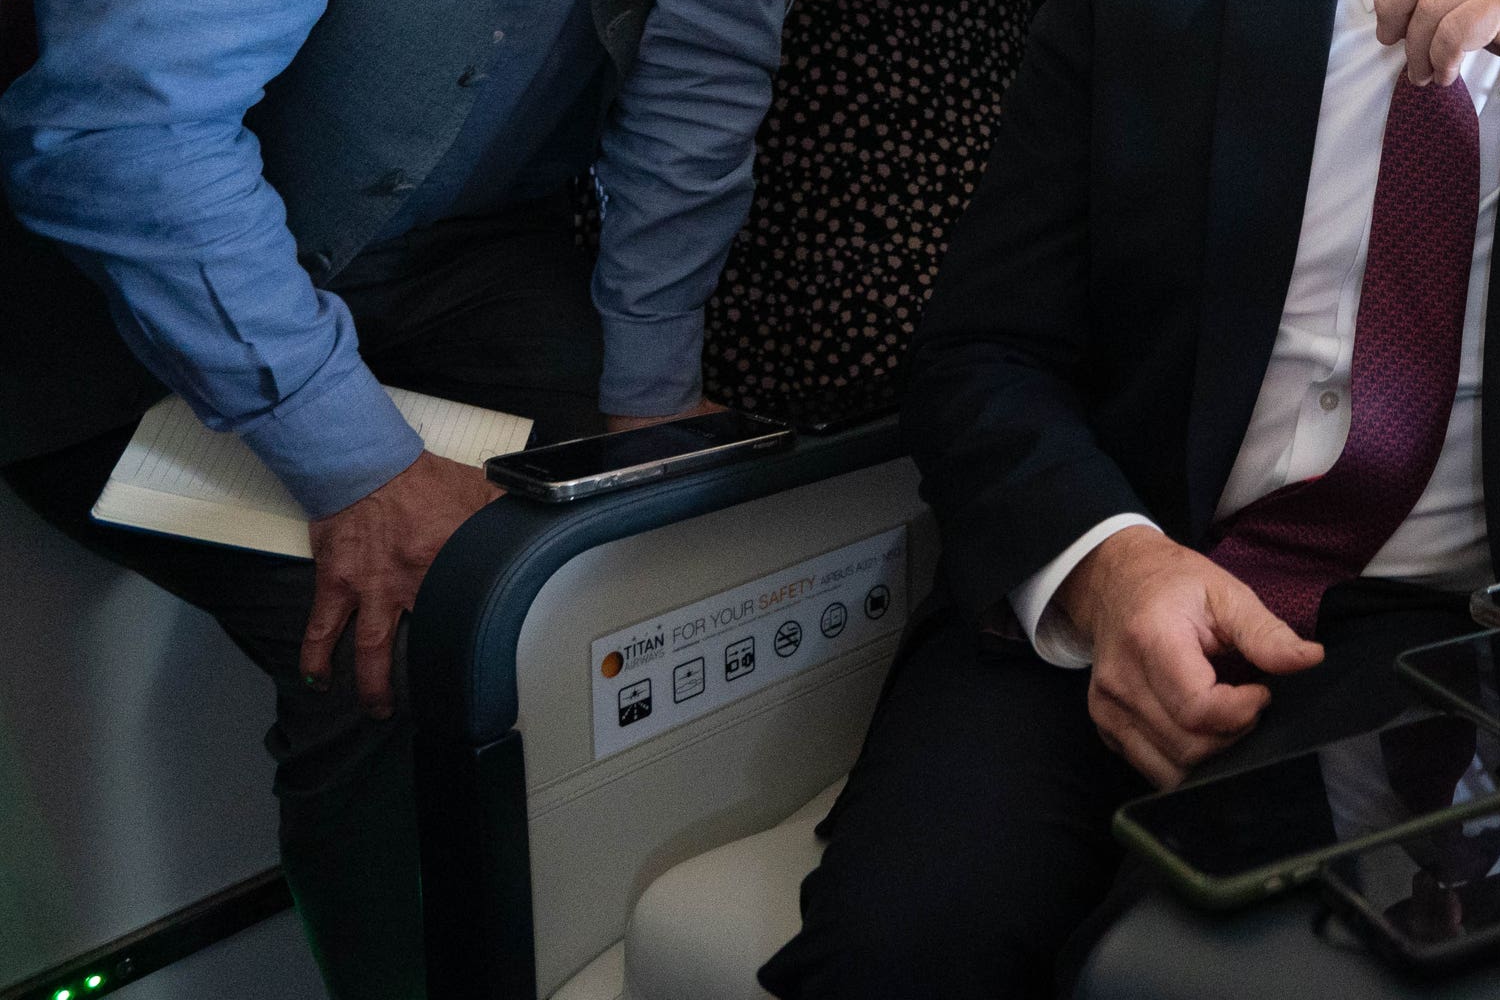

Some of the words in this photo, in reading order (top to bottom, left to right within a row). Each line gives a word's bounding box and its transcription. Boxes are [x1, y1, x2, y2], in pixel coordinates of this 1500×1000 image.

[672, 617, 706, 644] FOR
[709, 599, 754, 629] YOUR
[758, 574, 815, 609] SAFETY
[624, 633, 665, 660] TITAN
[624, 647, 665, 672] AIRWAYS
